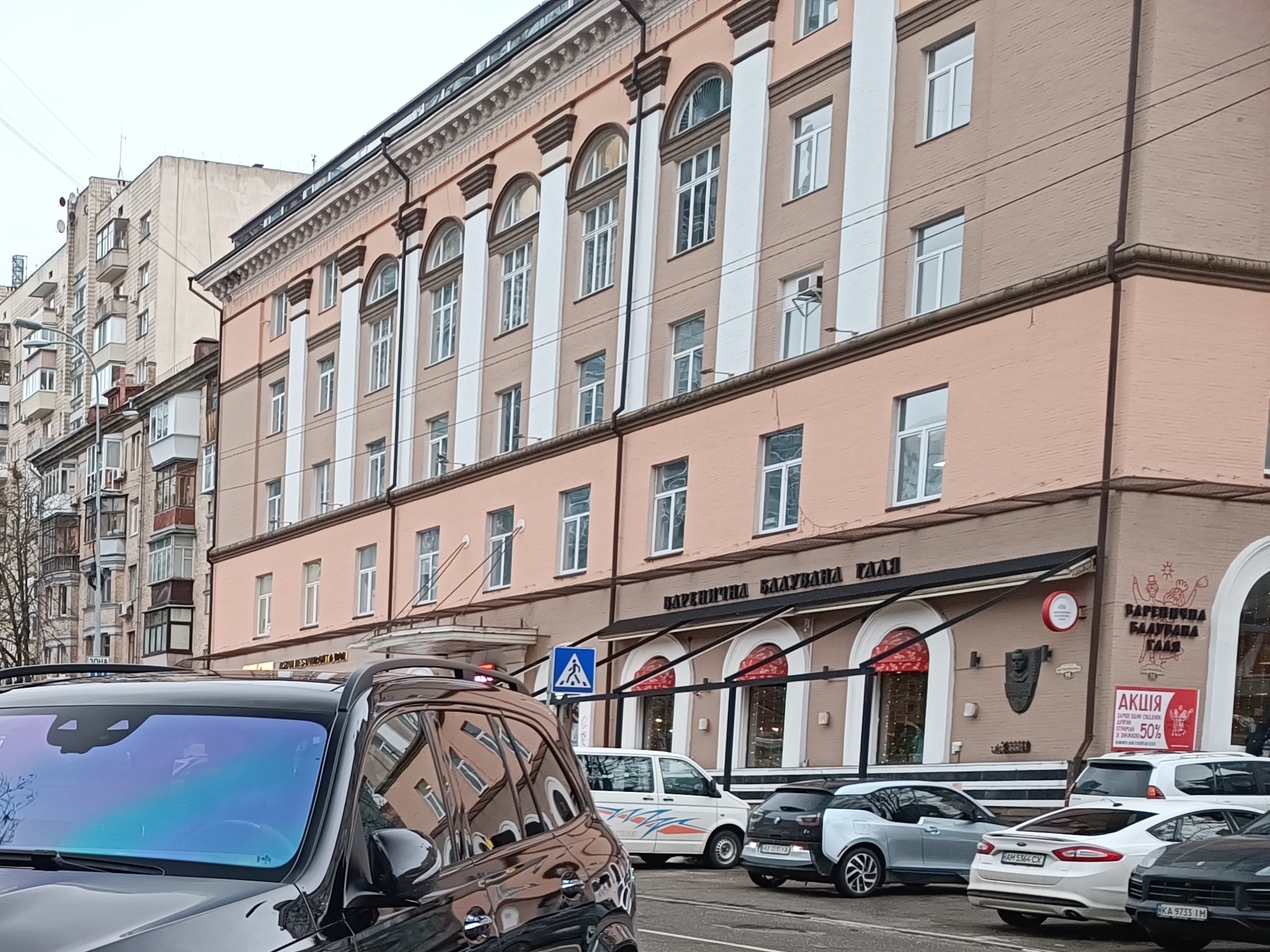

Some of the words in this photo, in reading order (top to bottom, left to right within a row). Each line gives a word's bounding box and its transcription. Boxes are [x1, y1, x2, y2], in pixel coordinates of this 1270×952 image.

[664, 583, 749, 610] ВАРЕНИЧНА
[760, 566, 843, 595] БАЛУВАНА
[856, 556, 901, 579] ГАЛЯ
[1125, 604, 1206, 621] ВАРЕНИЧНА
[1130, 621, 1199, 637] БАЛУВАНА
[1146, 639, 1181, 653] ГАЛЯ
[1118, 693, 1162, 712] АКЦІЯ
[1140, 723, 1161, 739] 50%
[1161, 906, 1173, 915] KA
[1174, 907, 1192, 916] 9733
